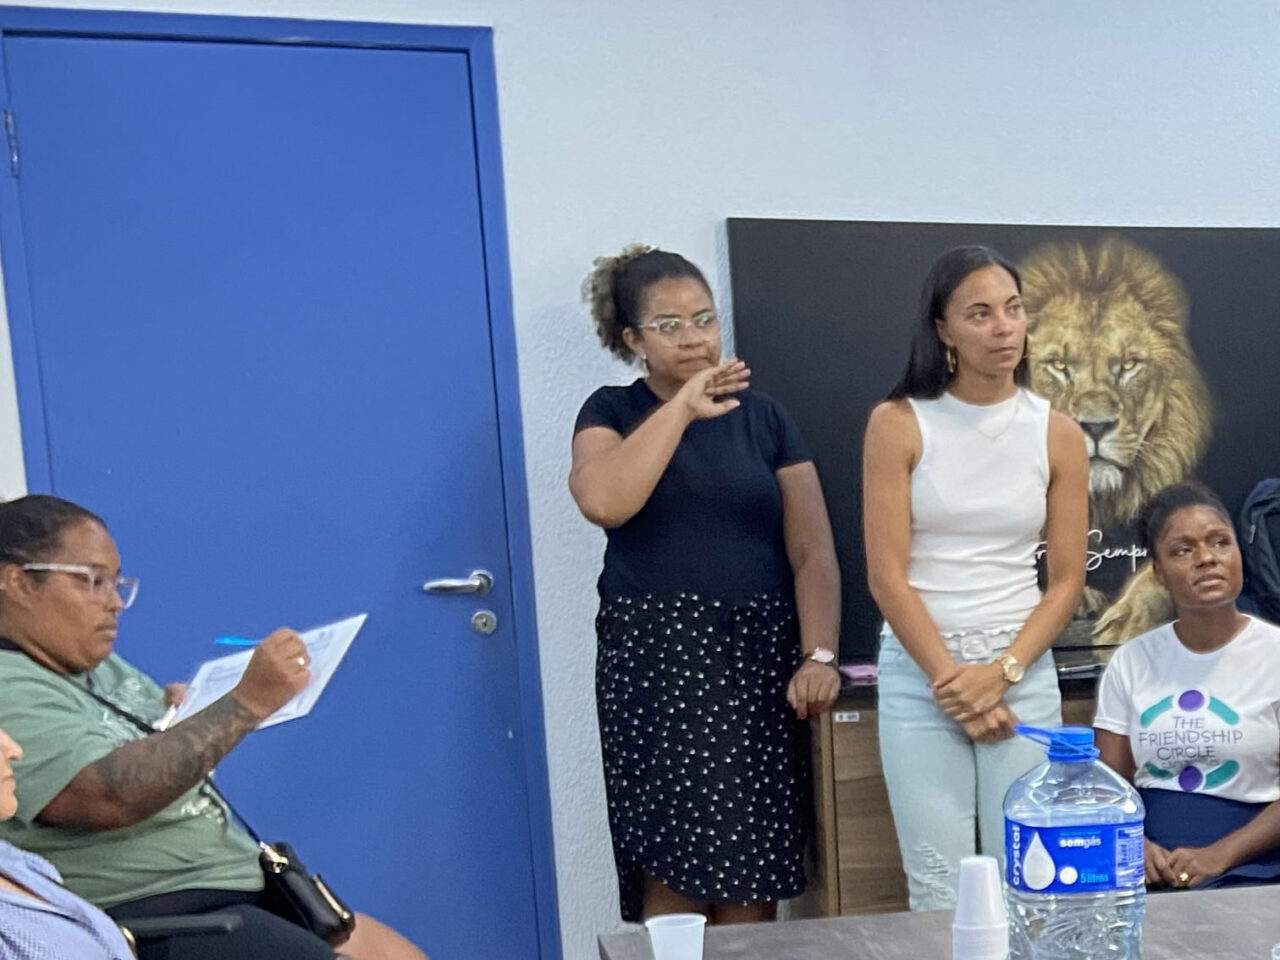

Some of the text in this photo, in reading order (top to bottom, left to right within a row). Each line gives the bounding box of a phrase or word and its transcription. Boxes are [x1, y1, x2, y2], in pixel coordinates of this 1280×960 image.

[1173, 716, 1205, 729] THE
[1138, 730, 1243, 747] FRIENDSHIP
[1156, 746, 1216, 760] CIRCLE
